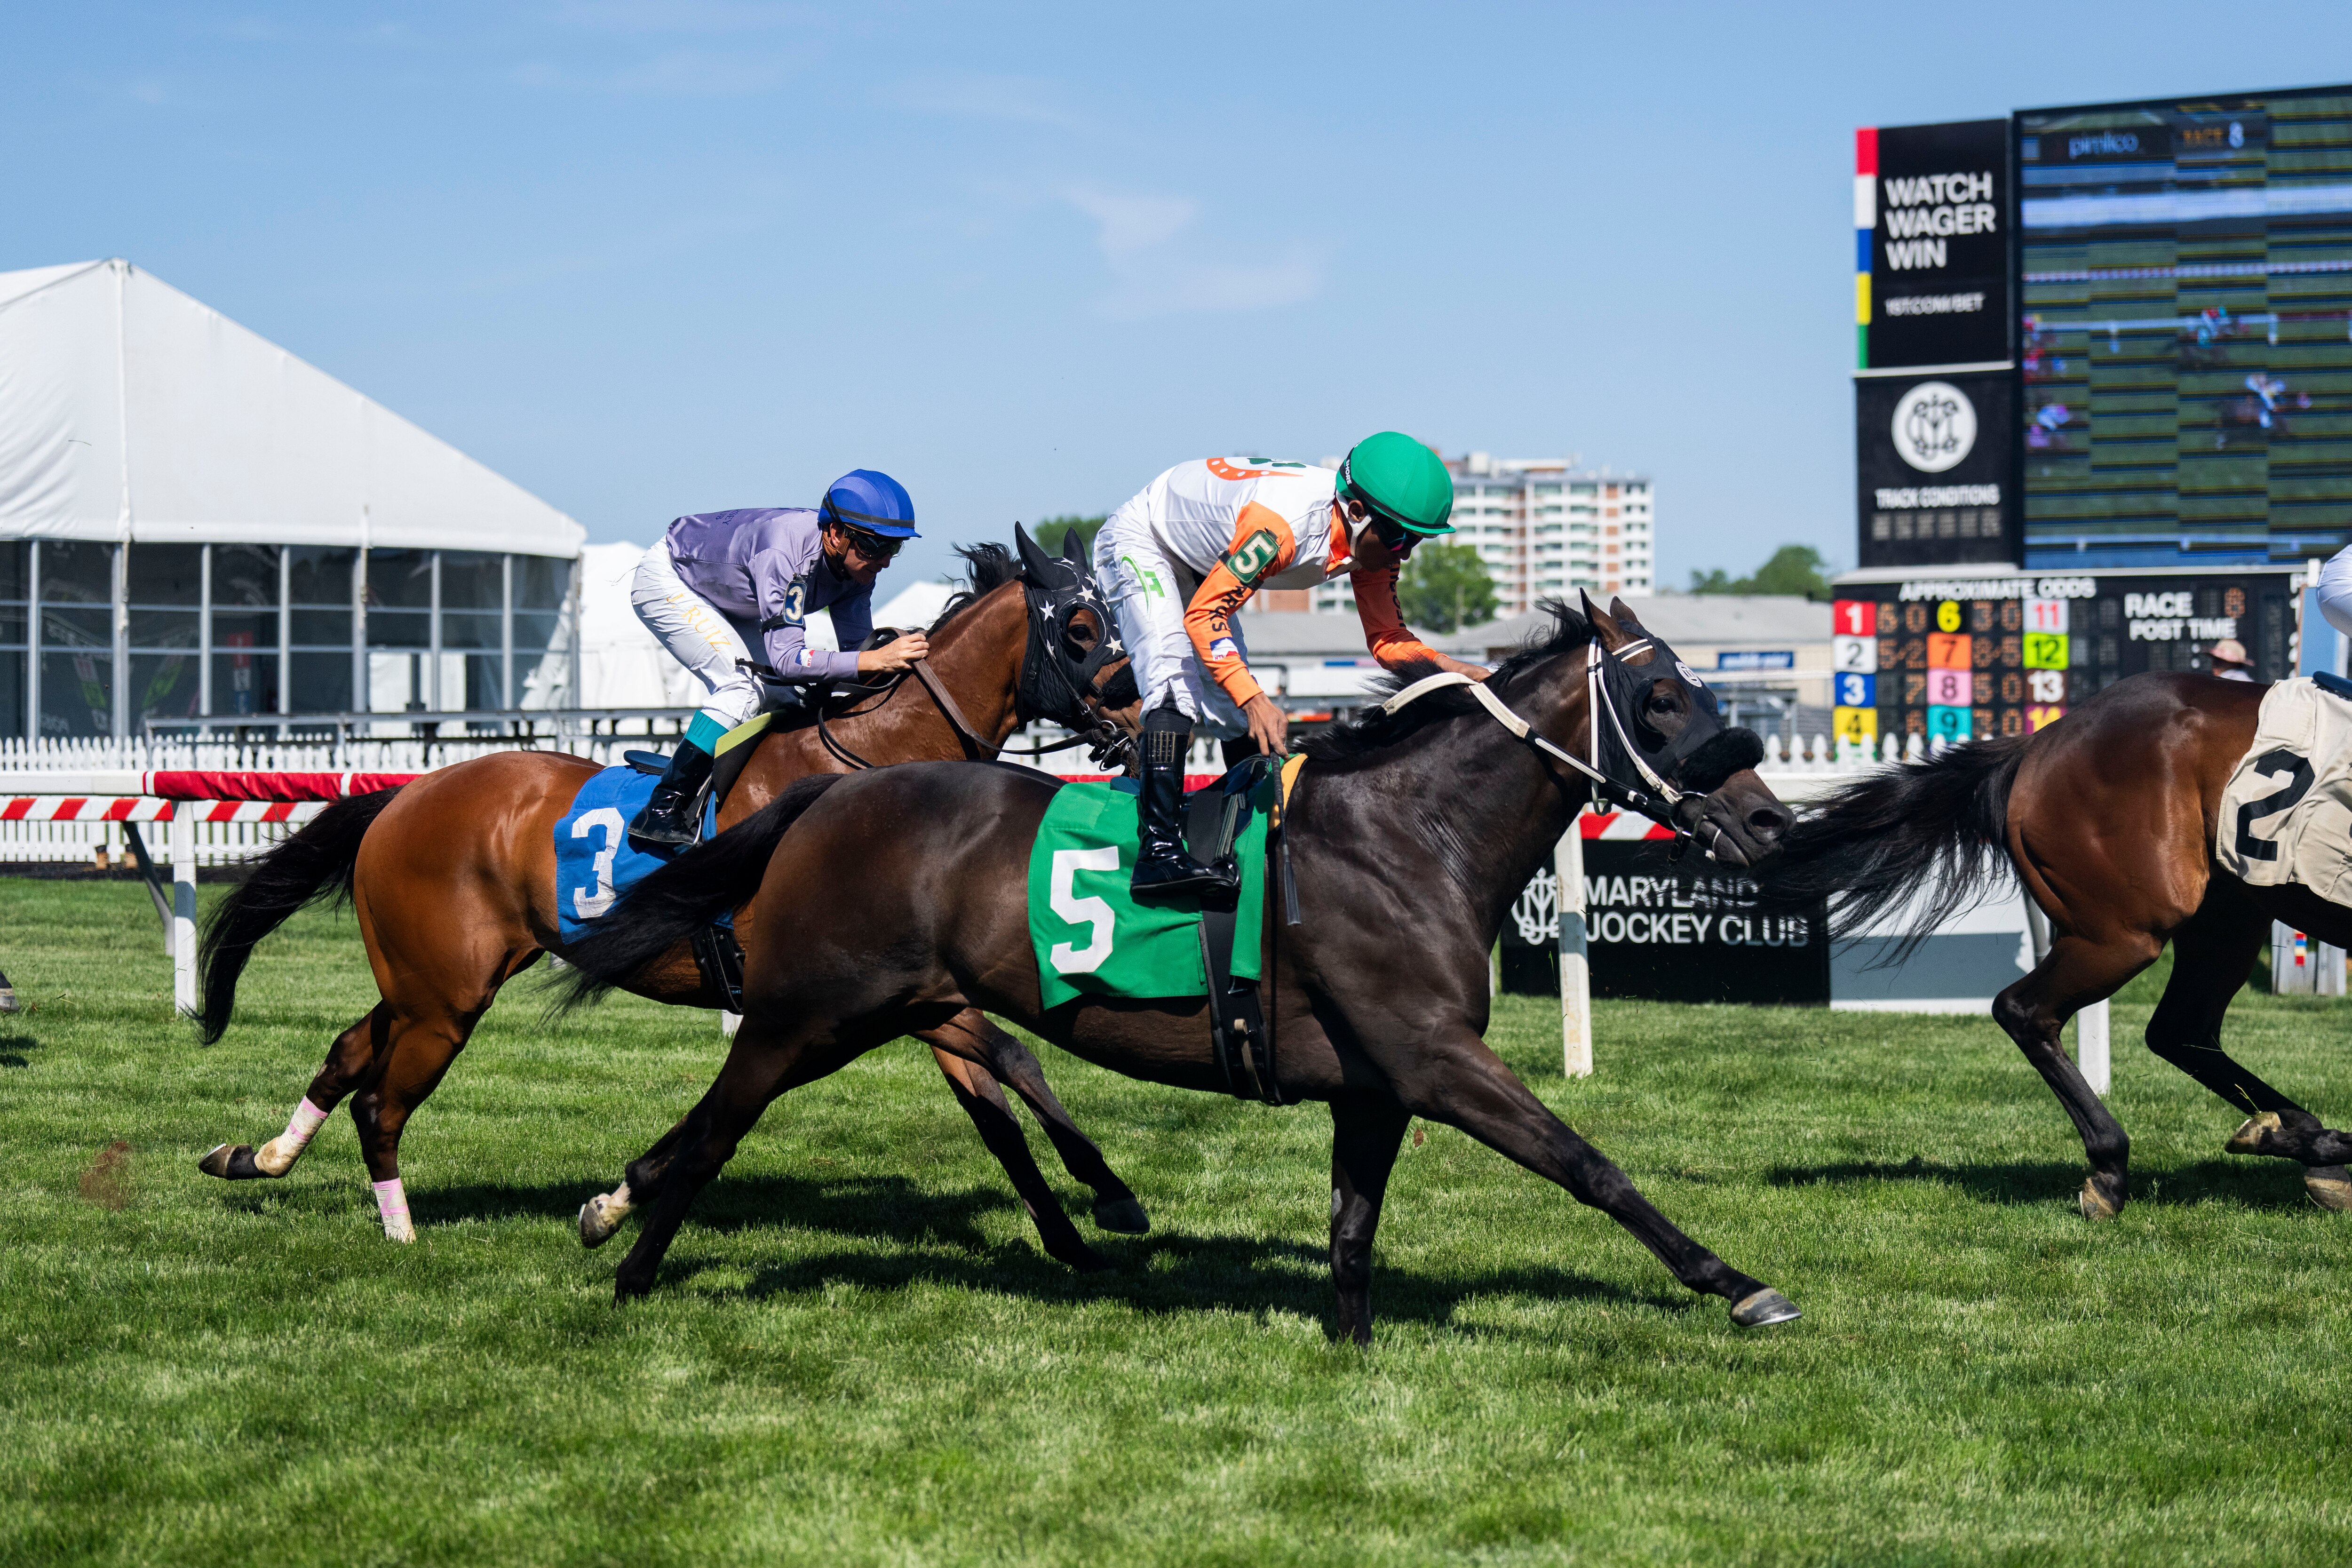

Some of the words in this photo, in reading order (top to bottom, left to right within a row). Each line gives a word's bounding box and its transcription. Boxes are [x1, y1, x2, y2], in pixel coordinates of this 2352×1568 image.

[1884, 171, 1993, 207] WATCH
[1884, 203, 1996, 239] WAGER
[1885, 239, 1947, 271] WIN
[1875, 488, 1919, 509] TRACK
[1919, 484, 2000, 507] CONDITIONS
[1235, 534, 1273, 573] 5
[786, 585, 804, 621] 3
[1899, 579, 2035, 602] APPROXIMATE
[2037, 577, 2096, 597] ODDS
[2124, 591, 2193, 619] RACE
[681, 605, 731, 652] RUIZ
[1845, 603, 1863, 634] 1
[1937, 601, 1961, 632] 6
[2034, 602, 2059, 628] 11
[2129, 619, 2185, 641] POST
[2187, 618, 2237, 640] TIME
[1847, 643, 1864, 667] 2
[1941, 640, 1958, 667] 7
[2034, 639, 2059, 664] 12
[1843, 673, 1865, 705] 3
[1906, 673, 1926, 704] 7
[1941, 676, 1957, 700] 8
[2027, 670, 2065, 702] 13
[1846, 714, 1862, 736] 4
[1940, 711, 1957, 736] 9
[2235, 748, 2315, 861] 2
[572, 807, 625, 919] 3
[1584, 875, 1759, 908] MARYLAND
[1049, 846, 1120, 973] 5
[1586, 912, 1712, 944] JOCKEY
[1719, 914, 1809, 947] CLUB
